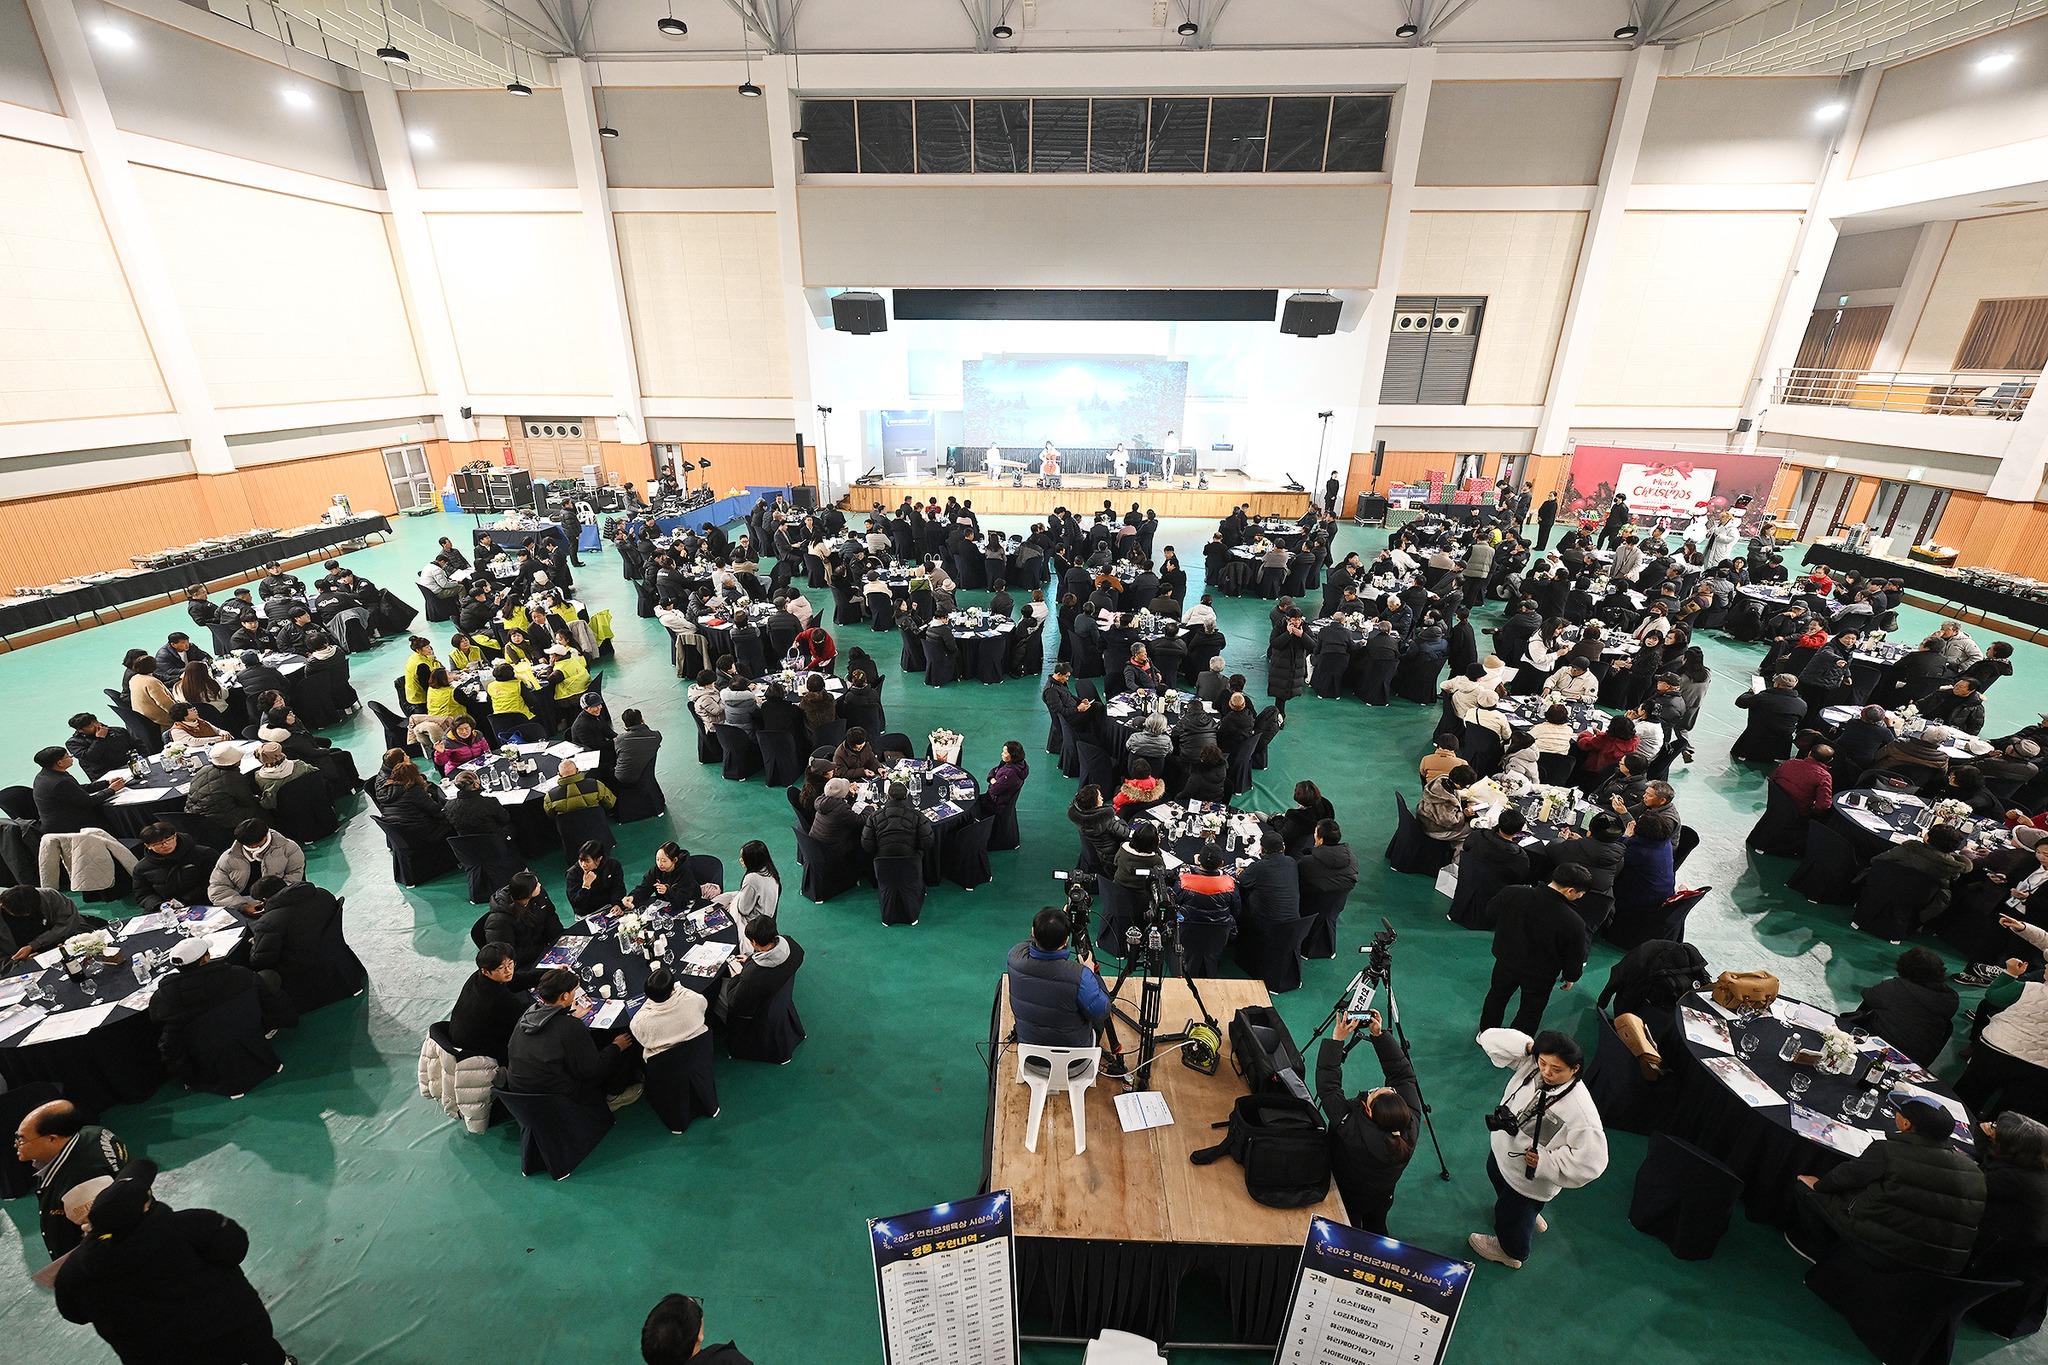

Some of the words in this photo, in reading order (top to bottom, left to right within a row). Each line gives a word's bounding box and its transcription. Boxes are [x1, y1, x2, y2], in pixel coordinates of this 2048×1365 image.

[1652, 478, 1678, 488] Merry
[893, 1231, 915, 1243] 2025
[916, 1220, 967, 1237] 연천군체육상
[969, 1213, 994, 1226] 시상식
[911, 1243, 933, 1257] 경품
[935, 1233, 977, 1250] 후원내역
[1327, 1245, 1351, 1257] 2025
[1353, 1252, 1410, 1276] 연천군체육상
[1411, 1271, 1441, 1286] 시상식
[1352, 1268, 1376, 1283] 경품
[1379, 1277, 1404, 1292] 내역
[1308, 1301, 1314, 1309] 2
[1310, 1273, 1327, 1284] 구분
[1355, 1286, 1391, 1304] 경품목록
[1420, 1311, 1440, 1324] 수량
[1304, 1313, 1311, 1321] 3
[1413, 1354, 1420, 1362] 2
[1422, 1327, 1429, 1335] 2
